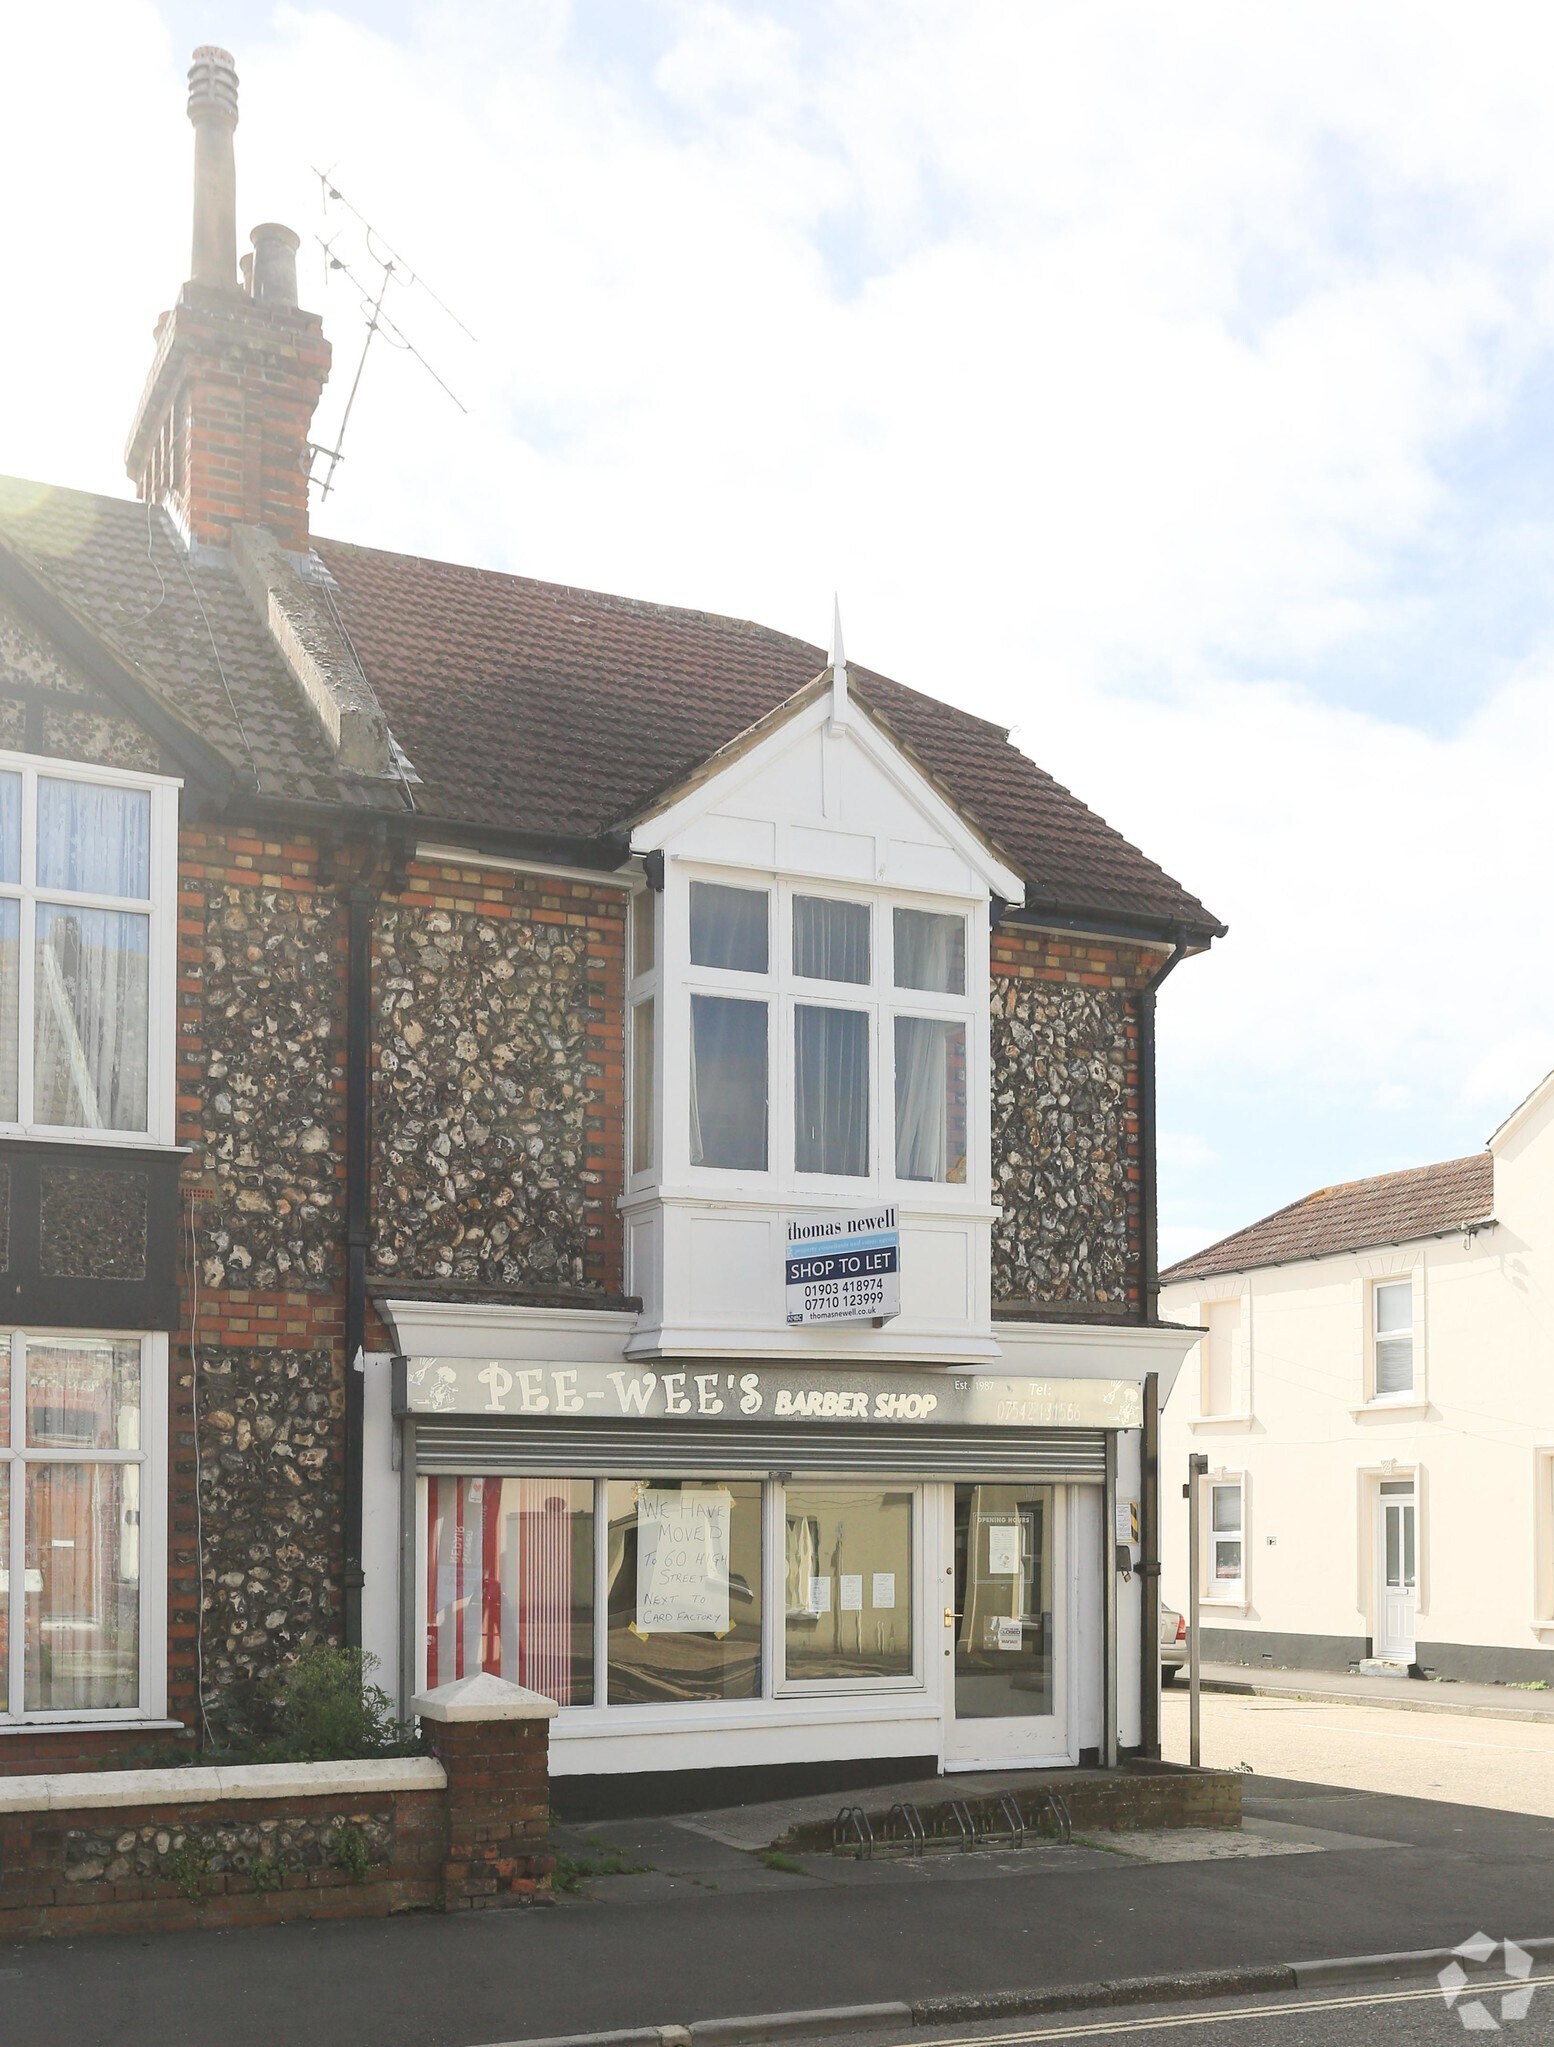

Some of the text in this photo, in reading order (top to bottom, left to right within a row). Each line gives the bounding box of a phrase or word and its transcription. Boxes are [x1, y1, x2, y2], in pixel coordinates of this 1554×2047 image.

[788, 1208, 895, 1240] thomas newell
[791, 1253, 891, 1279] SHOP TO LET
[804, 1278, 883, 1297] 01903 418974
[805, 1292, 884, 1311] 07710 123999
[810, 1306, 876, 1320] thomasnewell.co.uk
[477, 1361, 937, 1419] PEE-WEE'S BARBER SHOP
[954, 1380, 995, 1391] Est. 1987
[1029, 1383, 1053, 1396] Tel:
[658, 1524, 722, 1543] MOVED
[664, 1550, 687, 1568] 60
[659, 1569, 708, 1585] STREET
[644, 1593, 679, 1605] NEXT
[643, 1610, 721, 1624] CARD FACTORY
